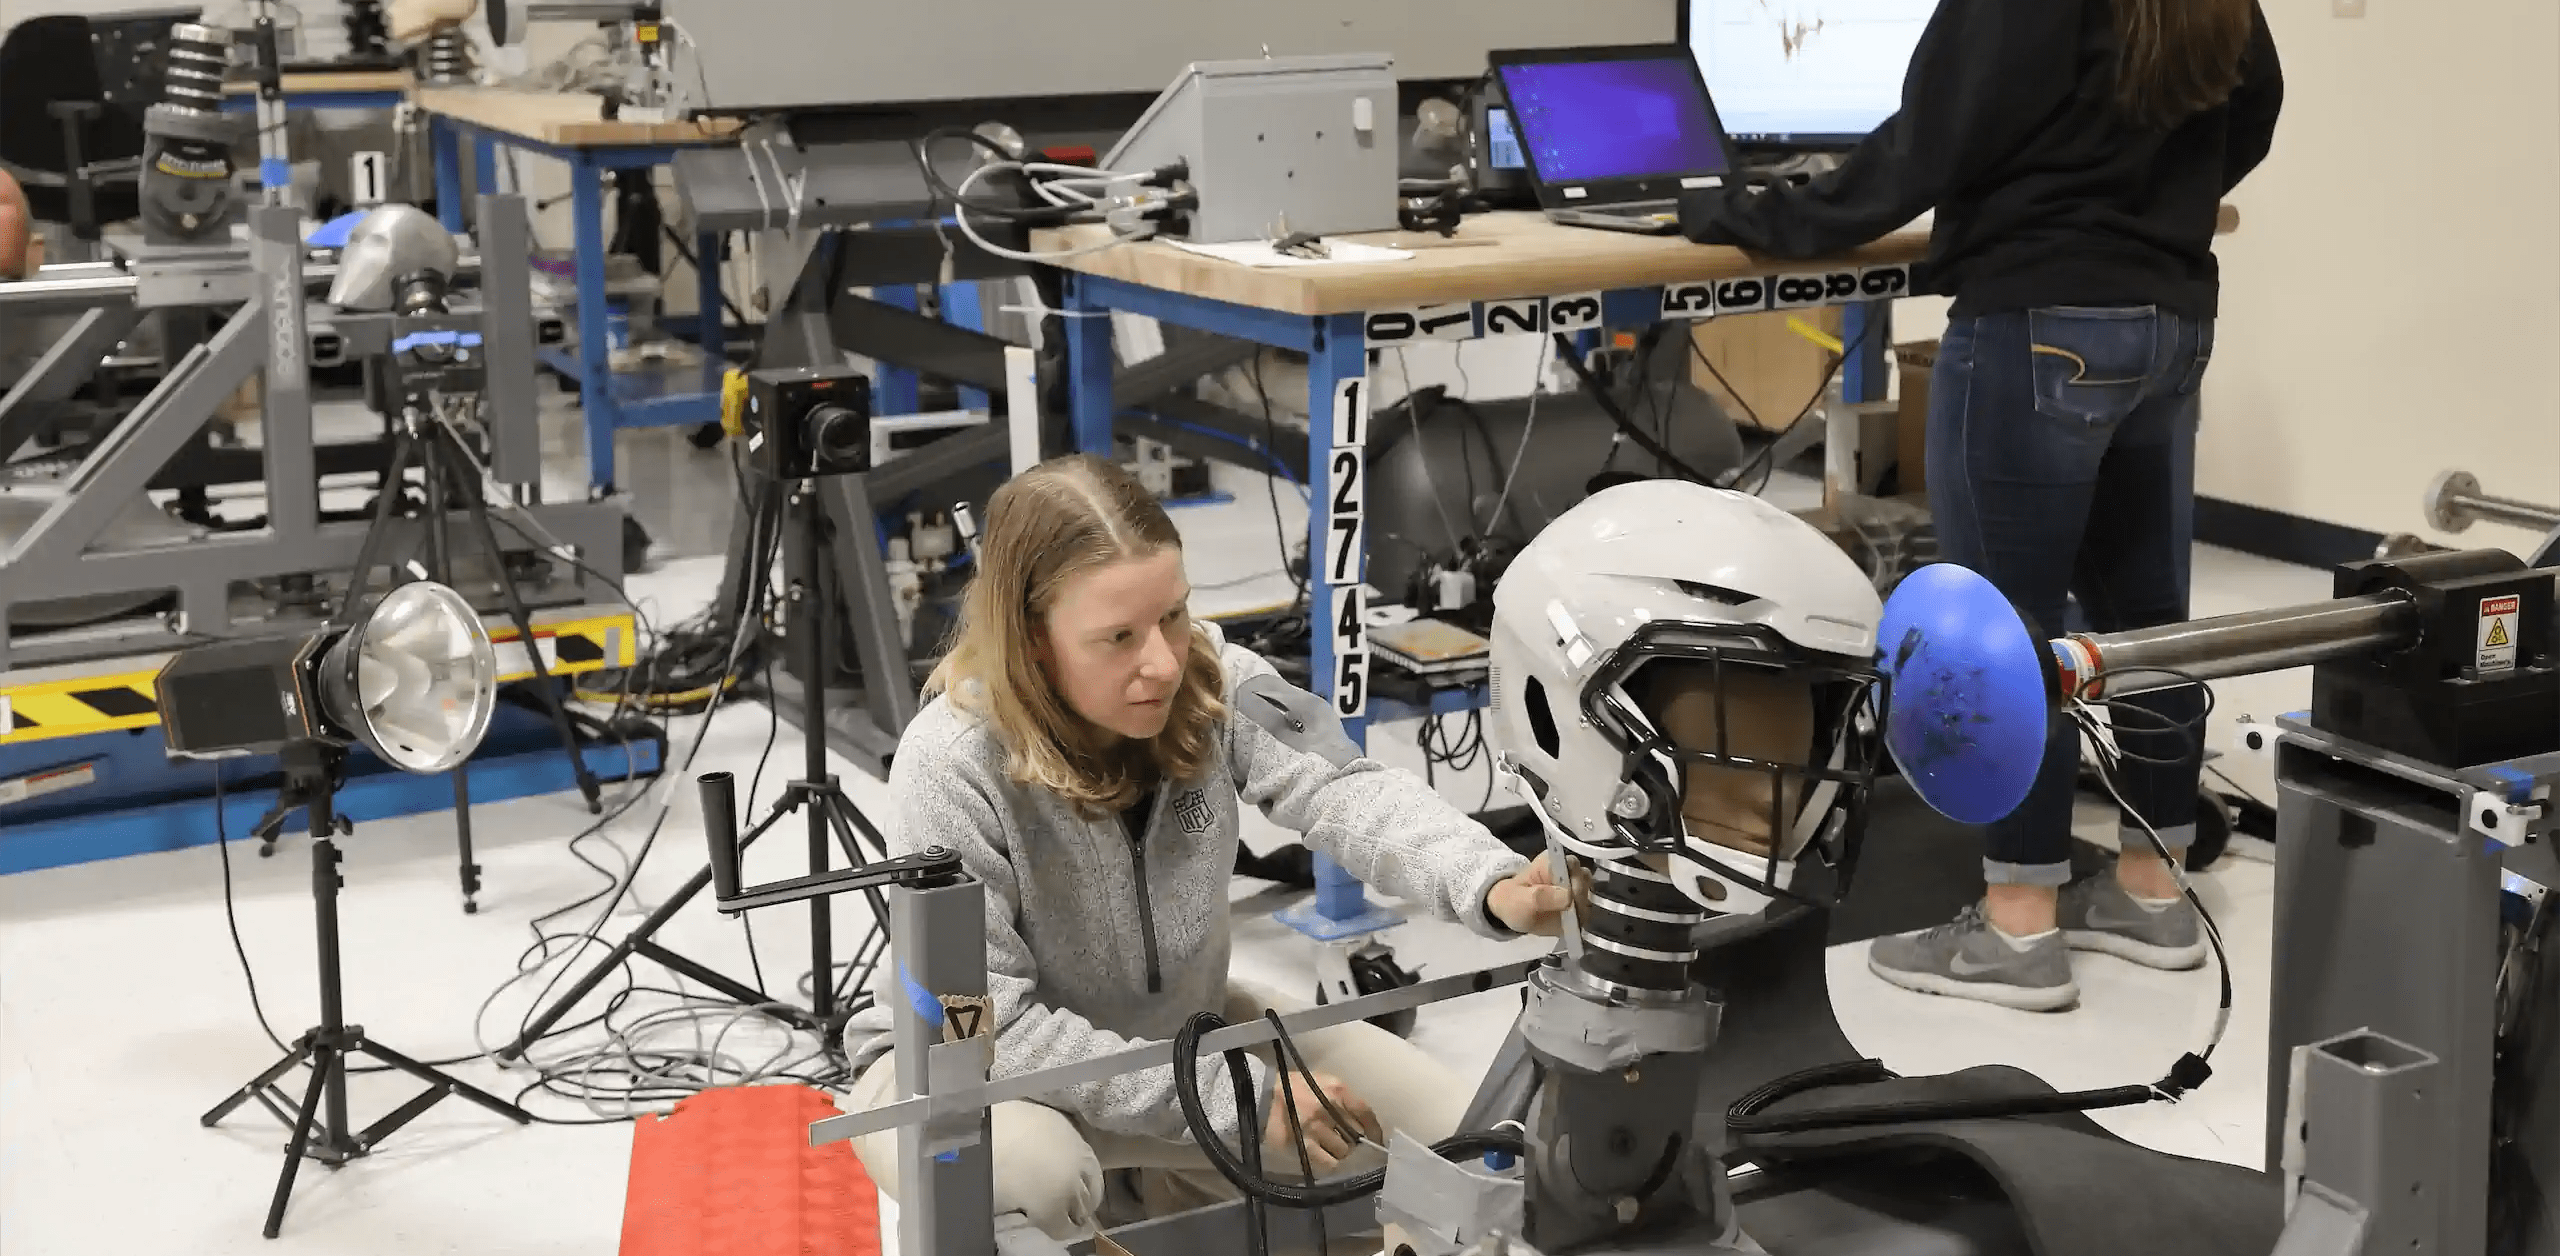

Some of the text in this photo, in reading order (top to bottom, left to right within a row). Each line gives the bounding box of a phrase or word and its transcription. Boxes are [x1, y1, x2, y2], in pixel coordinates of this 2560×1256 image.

[363, 156, 375, 199] 1
[1366, 312, 1416, 341] 0
[1419, 311, 1471, 335] 1
[1487, 304, 1538, 334] 2
[1550, 297, 1600, 326] 3
[1664, 285, 1711, 311] 5
[1717, 280, 1764, 308] 6
[1777, 278, 1825, 303] 8
[1859, 267, 1906, 295] 9
[1181, 807, 1211, 830] NFL
